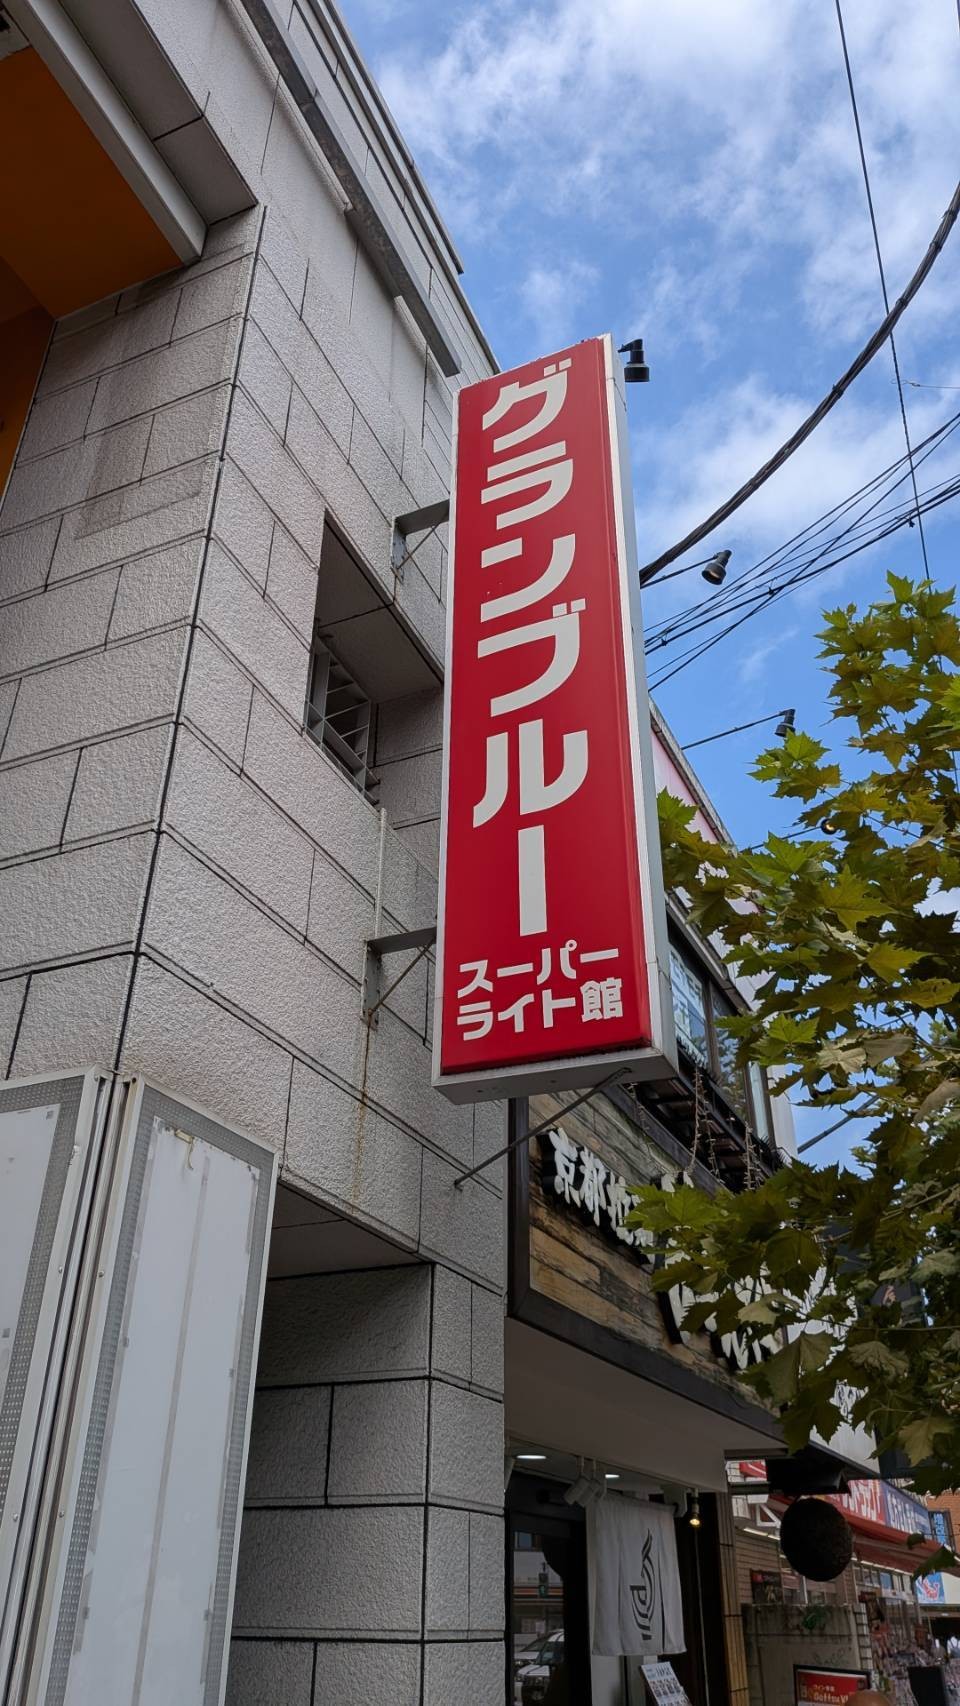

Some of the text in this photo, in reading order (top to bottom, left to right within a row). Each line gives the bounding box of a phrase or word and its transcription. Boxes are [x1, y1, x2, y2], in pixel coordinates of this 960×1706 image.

[473, 357, 588, 936] グランブルー
[457, 939, 619, 999] スーパー
[457, 977, 623, 1041] ライト館
